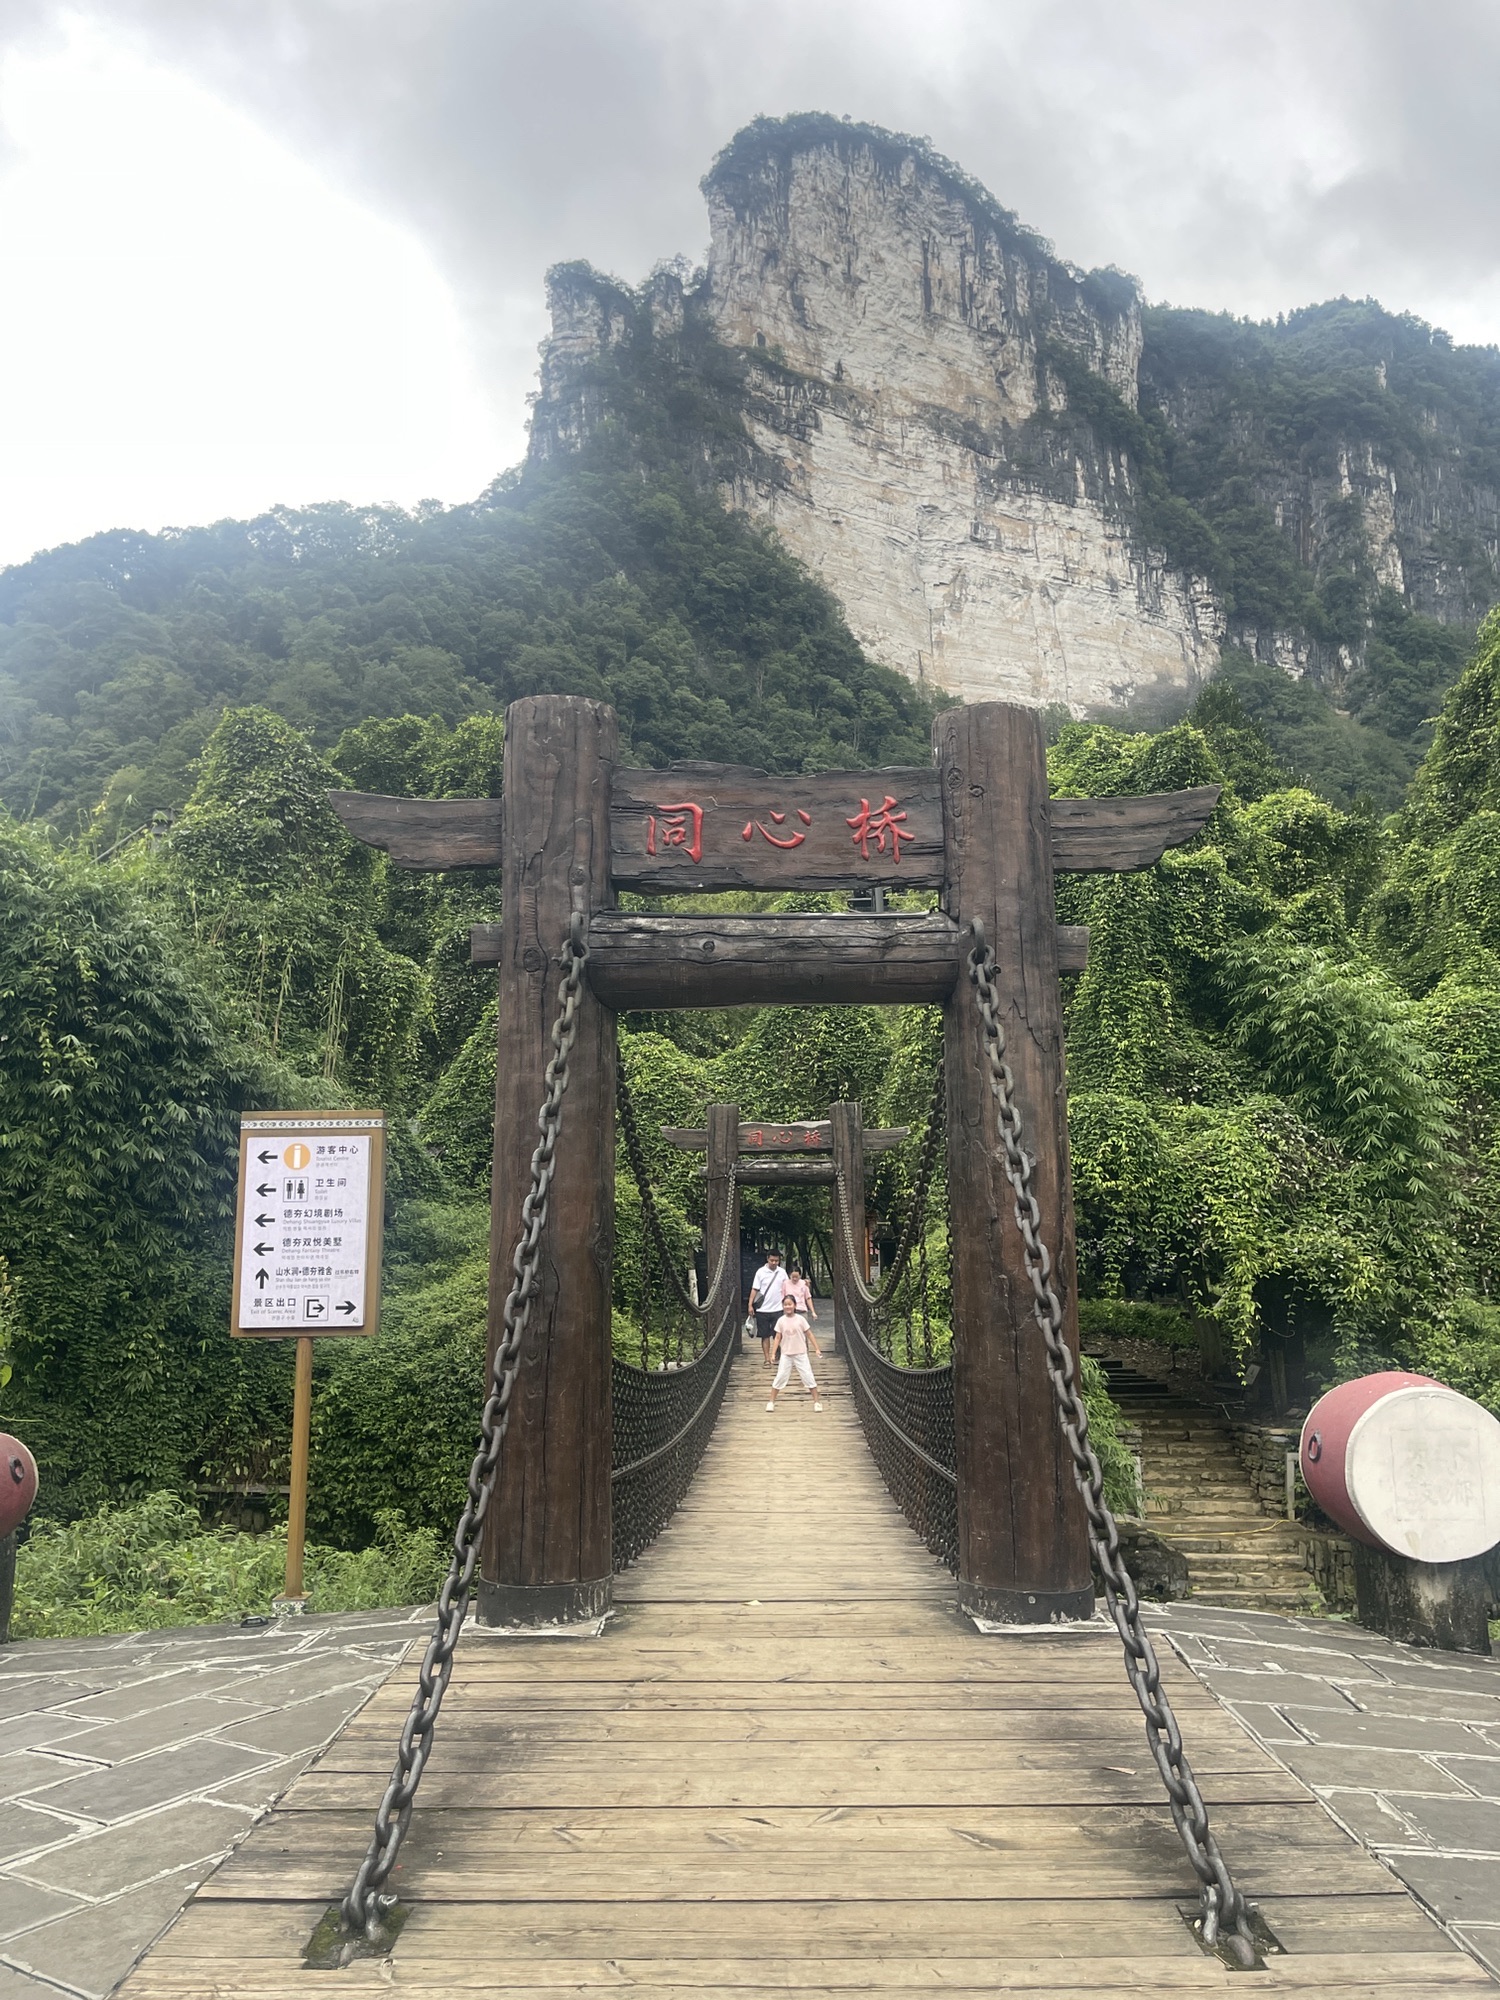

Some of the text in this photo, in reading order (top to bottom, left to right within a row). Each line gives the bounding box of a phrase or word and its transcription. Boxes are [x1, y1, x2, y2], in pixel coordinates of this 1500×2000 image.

[646, 795, 915, 864] 同心桥
[747, 1129, 822, 1147] 同心桥
[316, 1145, 359, 1155] 游客中心
[315, 1178, 347, 1188] 卫生间
[283, 1208, 343, 1218] 德夯幻境剧场
[282, 1237, 342, 1247] 德夯双悦美墅
[253, 1298, 296, 1307] 景区出口
